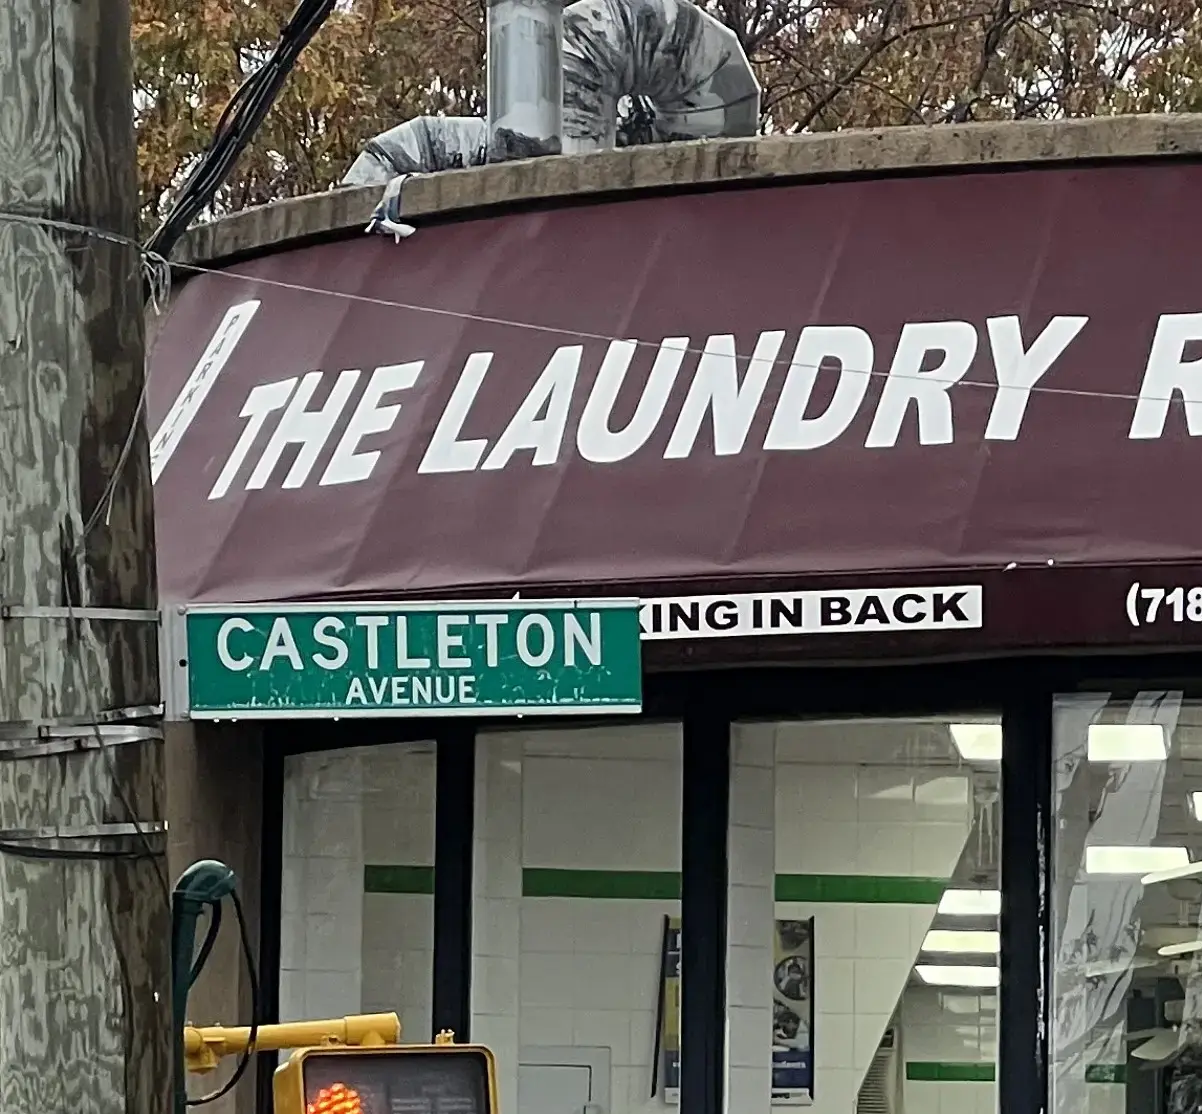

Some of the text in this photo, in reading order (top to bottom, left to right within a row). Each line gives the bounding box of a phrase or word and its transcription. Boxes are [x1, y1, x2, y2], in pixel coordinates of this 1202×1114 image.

[150, 314, 240, 466] PARKIN
[208, 361, 424, 500] THE
[418, 312, 1088, 473] LAUNDRY
[753, 598, 803, 629] IN
[820, 592, 968, 625] BACK
[217, 612, 602, 671] CASTLETON
[345, 675, 477, 706] AVENUE
